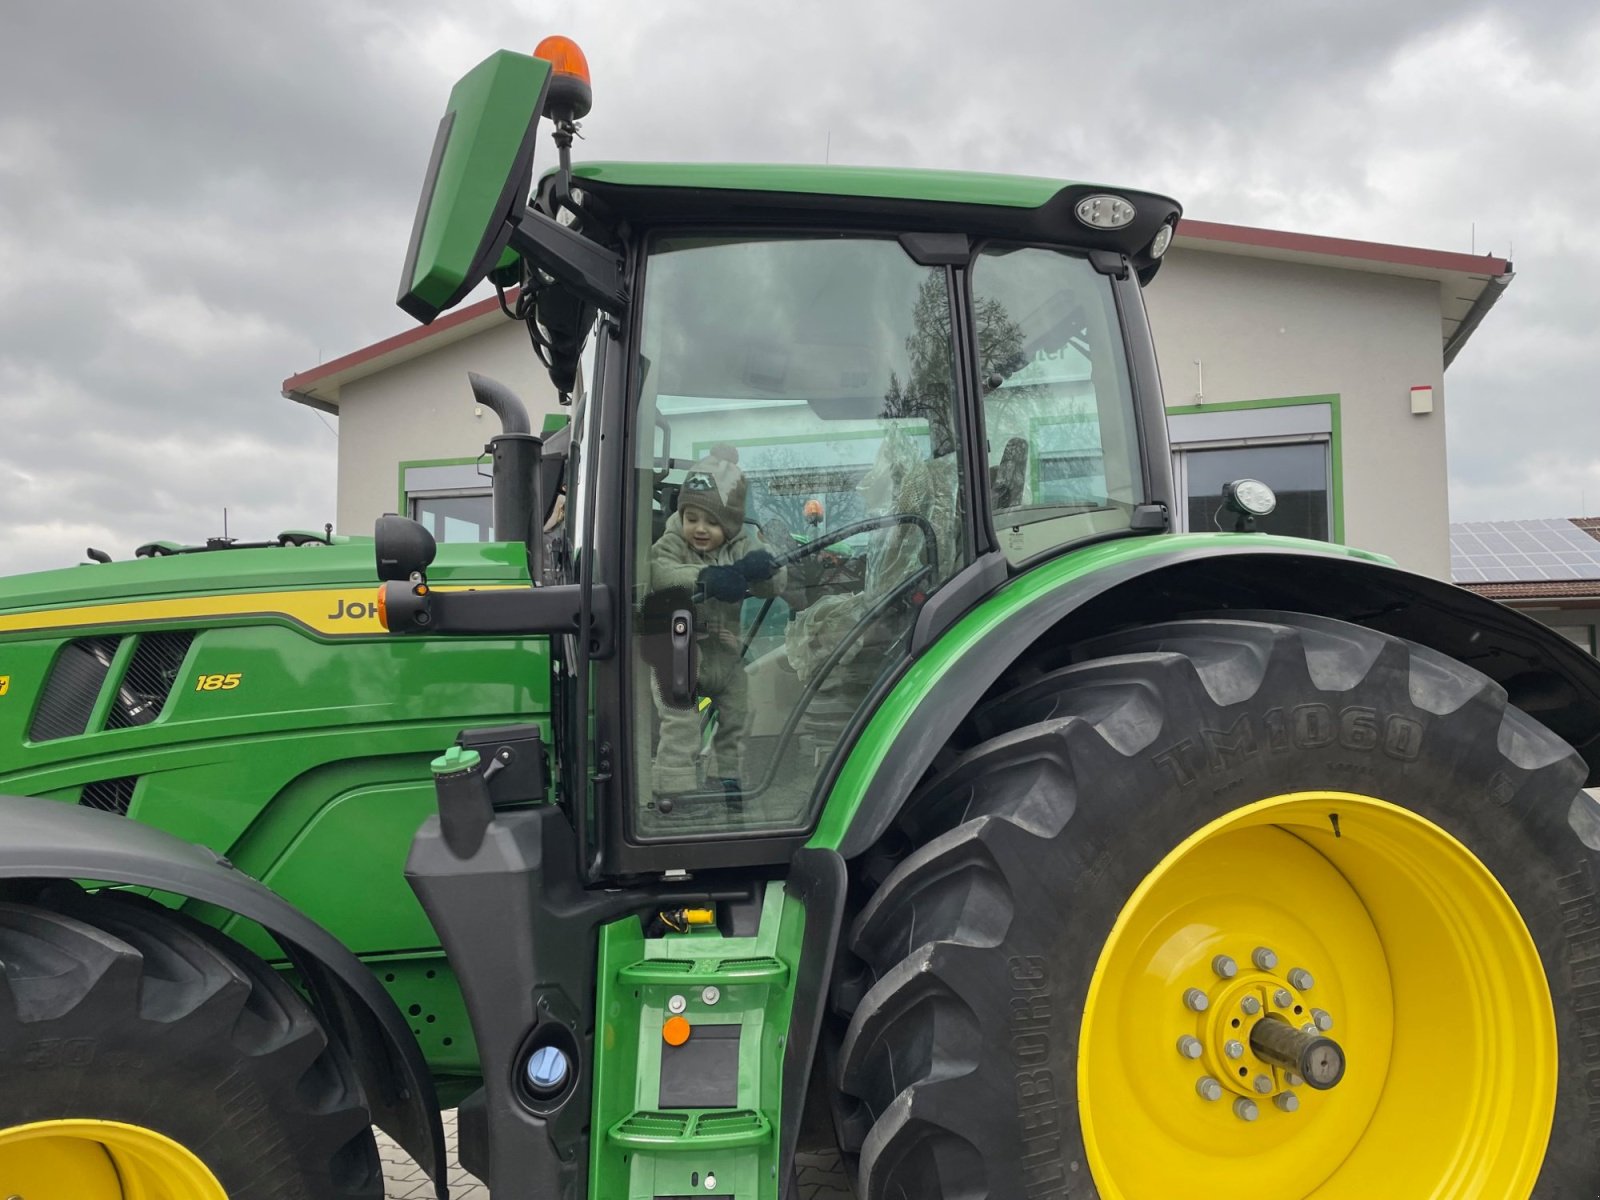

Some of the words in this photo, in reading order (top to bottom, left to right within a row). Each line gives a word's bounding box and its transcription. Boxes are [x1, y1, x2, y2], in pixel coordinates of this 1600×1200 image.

[328, 599, 379, 619] JOH
[195, 673, 242, 691] 185
[1151, 702, 1427, 788] TM1060
[1007, 955, 1067, 1200] LLEBORG
